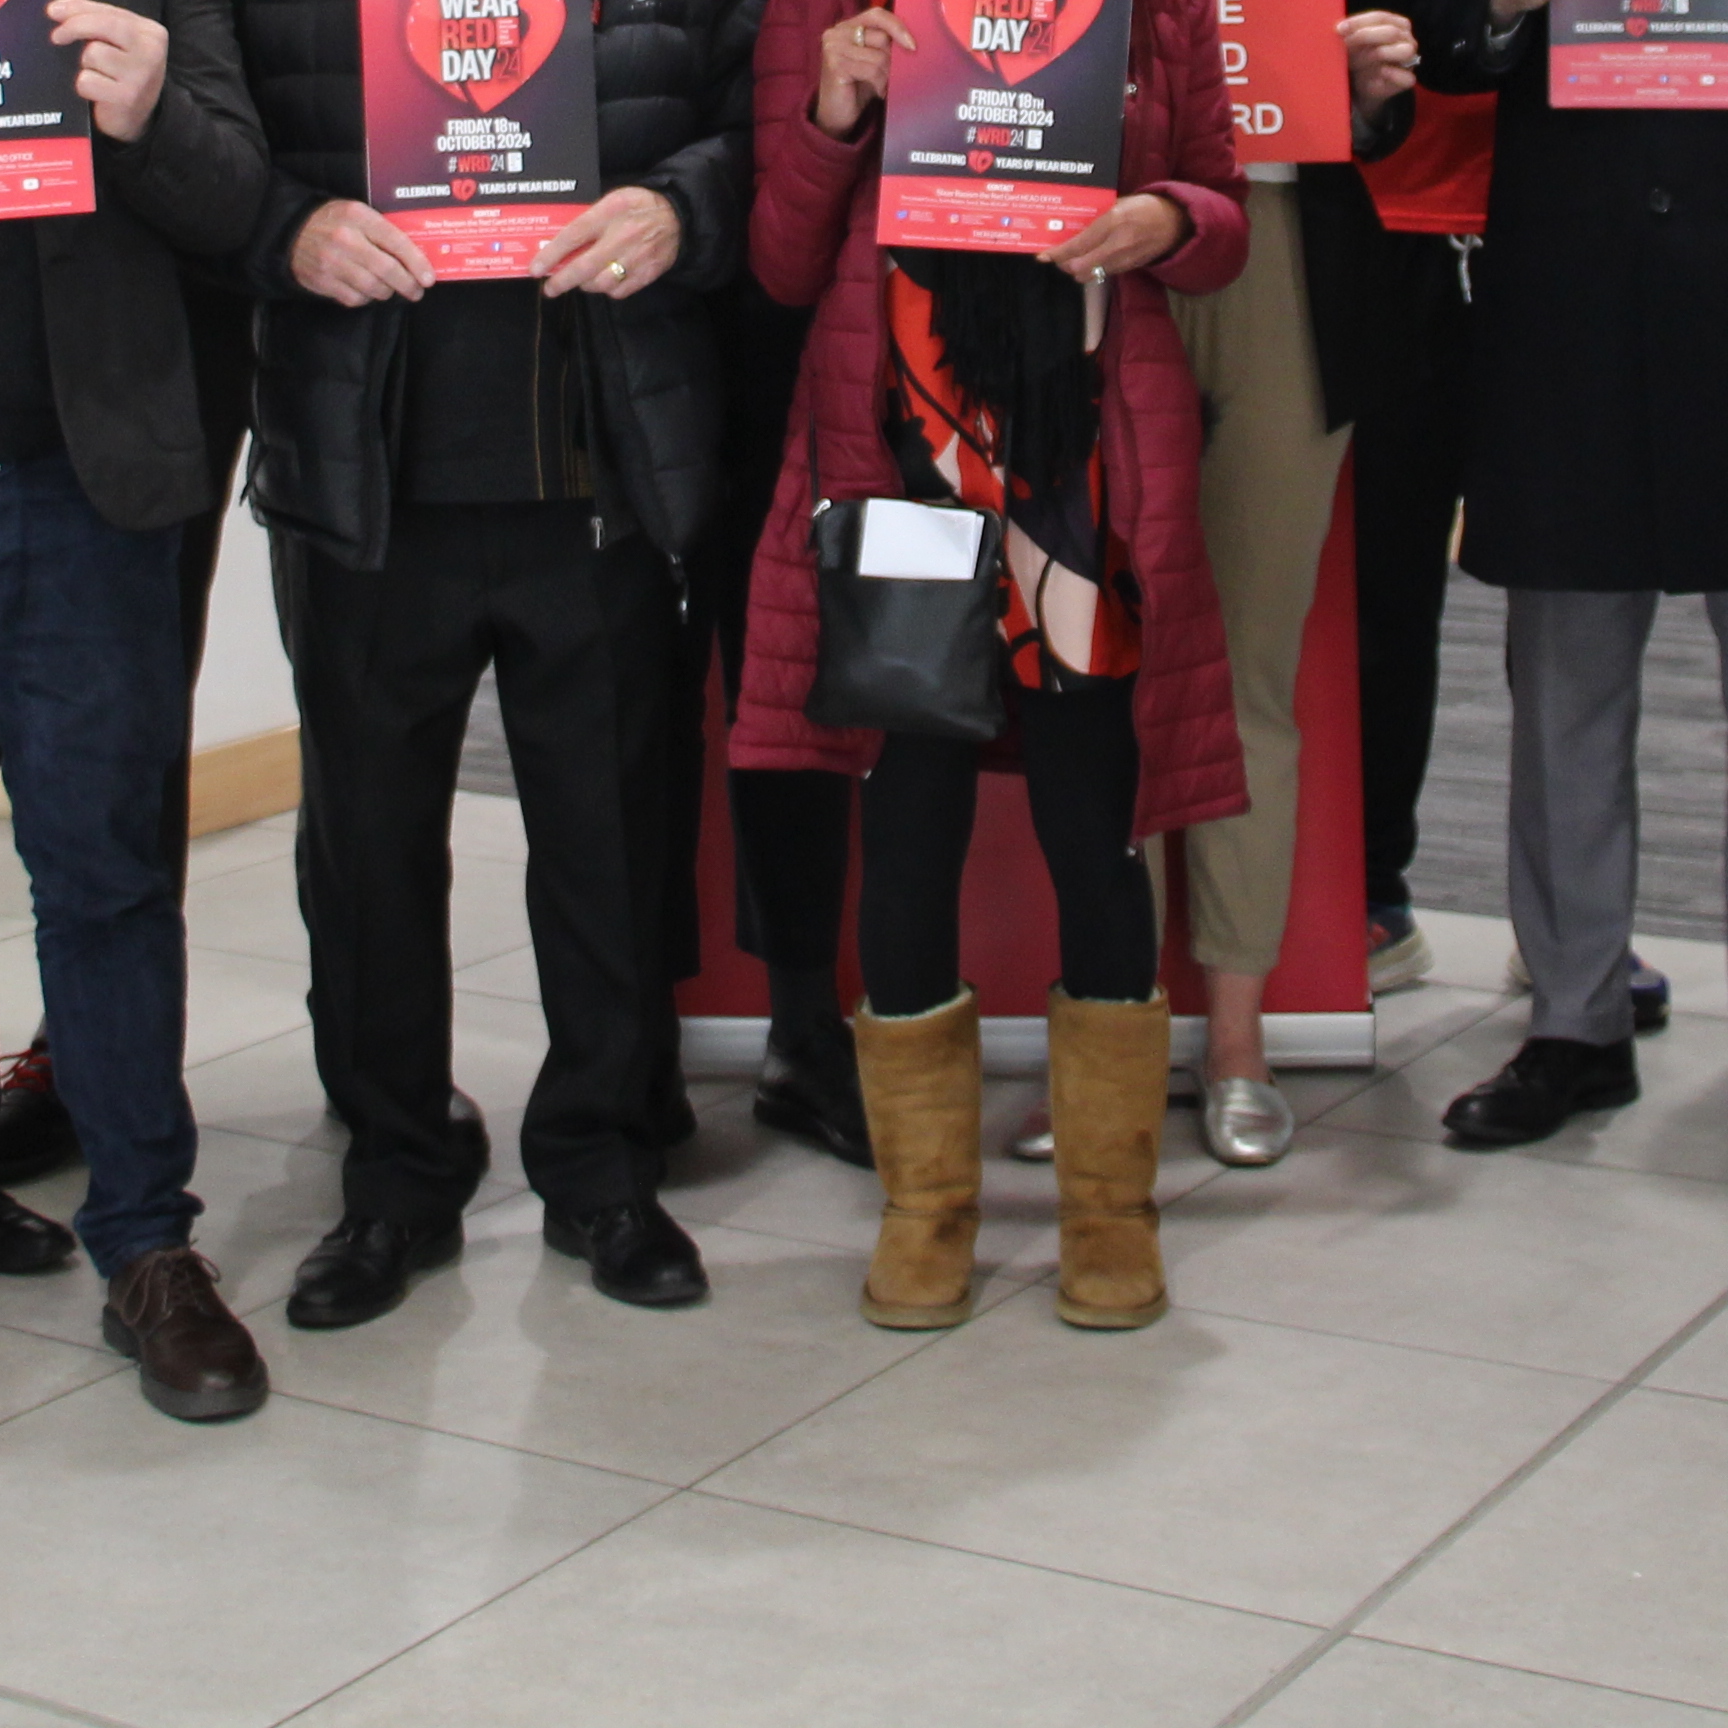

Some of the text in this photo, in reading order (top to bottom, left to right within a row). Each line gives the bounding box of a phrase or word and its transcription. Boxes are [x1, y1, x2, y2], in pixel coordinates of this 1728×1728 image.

[441, 18, 496, 50] RED
[971, 16, 1030, 53] DAY
[442, 49, 496, 82] DAY
[970, 89, 1045, 110] FRIDAY 18TH
[43, 112, 62, 124] DAY
[957, 104, 1055, 127] OCTOBER 2024
[1231, 102, 1284, 135] RD
[447, 118, 520, 135] FRIDAY 18TH
[967, 127, 1025, 147] #WRD24
[437, 132, 531, 152] OCTOBER 2024
[448, 154, 505, 173] #WRD24
[911, 151, 966, 166] CELEBRATING
[996, 157, 1023, 170] YEARS
[1035, 160, 1060, 172] WEAR
[1077, 162, 1094, 174] DAY
[396, 185, 451, 199] CELEBRATING
[479, 182, 507, 195] YEARS
[519, 181, 542, 193] WEAR
[559, 180, 577, 191] DAY
